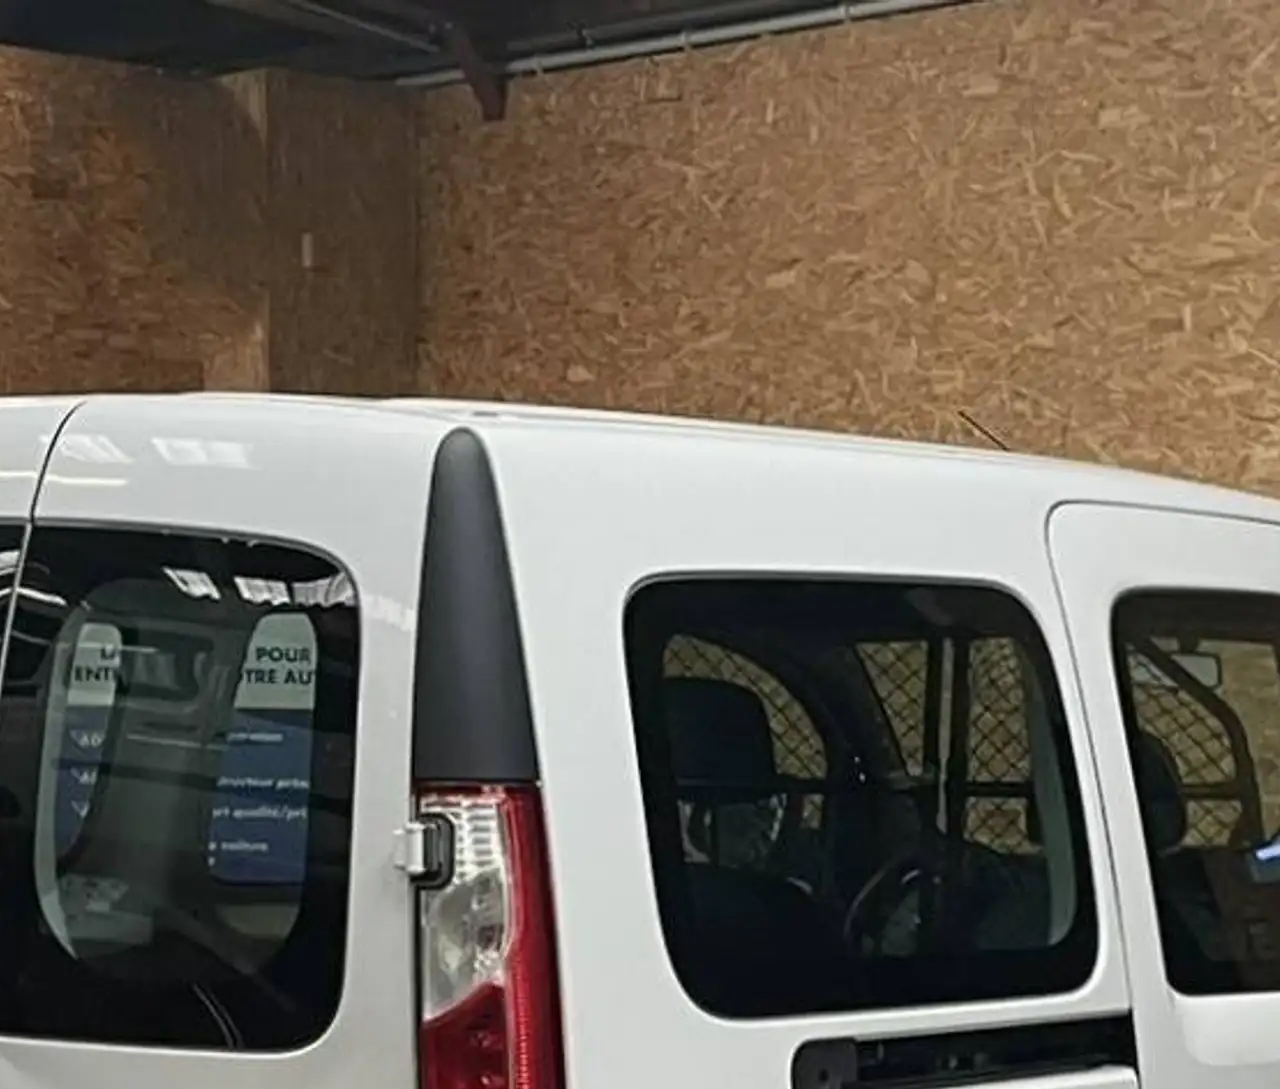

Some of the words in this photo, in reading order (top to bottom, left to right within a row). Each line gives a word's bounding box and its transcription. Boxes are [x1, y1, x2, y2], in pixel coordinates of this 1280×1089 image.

[256, 646, 311, 664] POUR
[240, 668, 278, 686] TRE
[285, 669, 314, 687] AU
